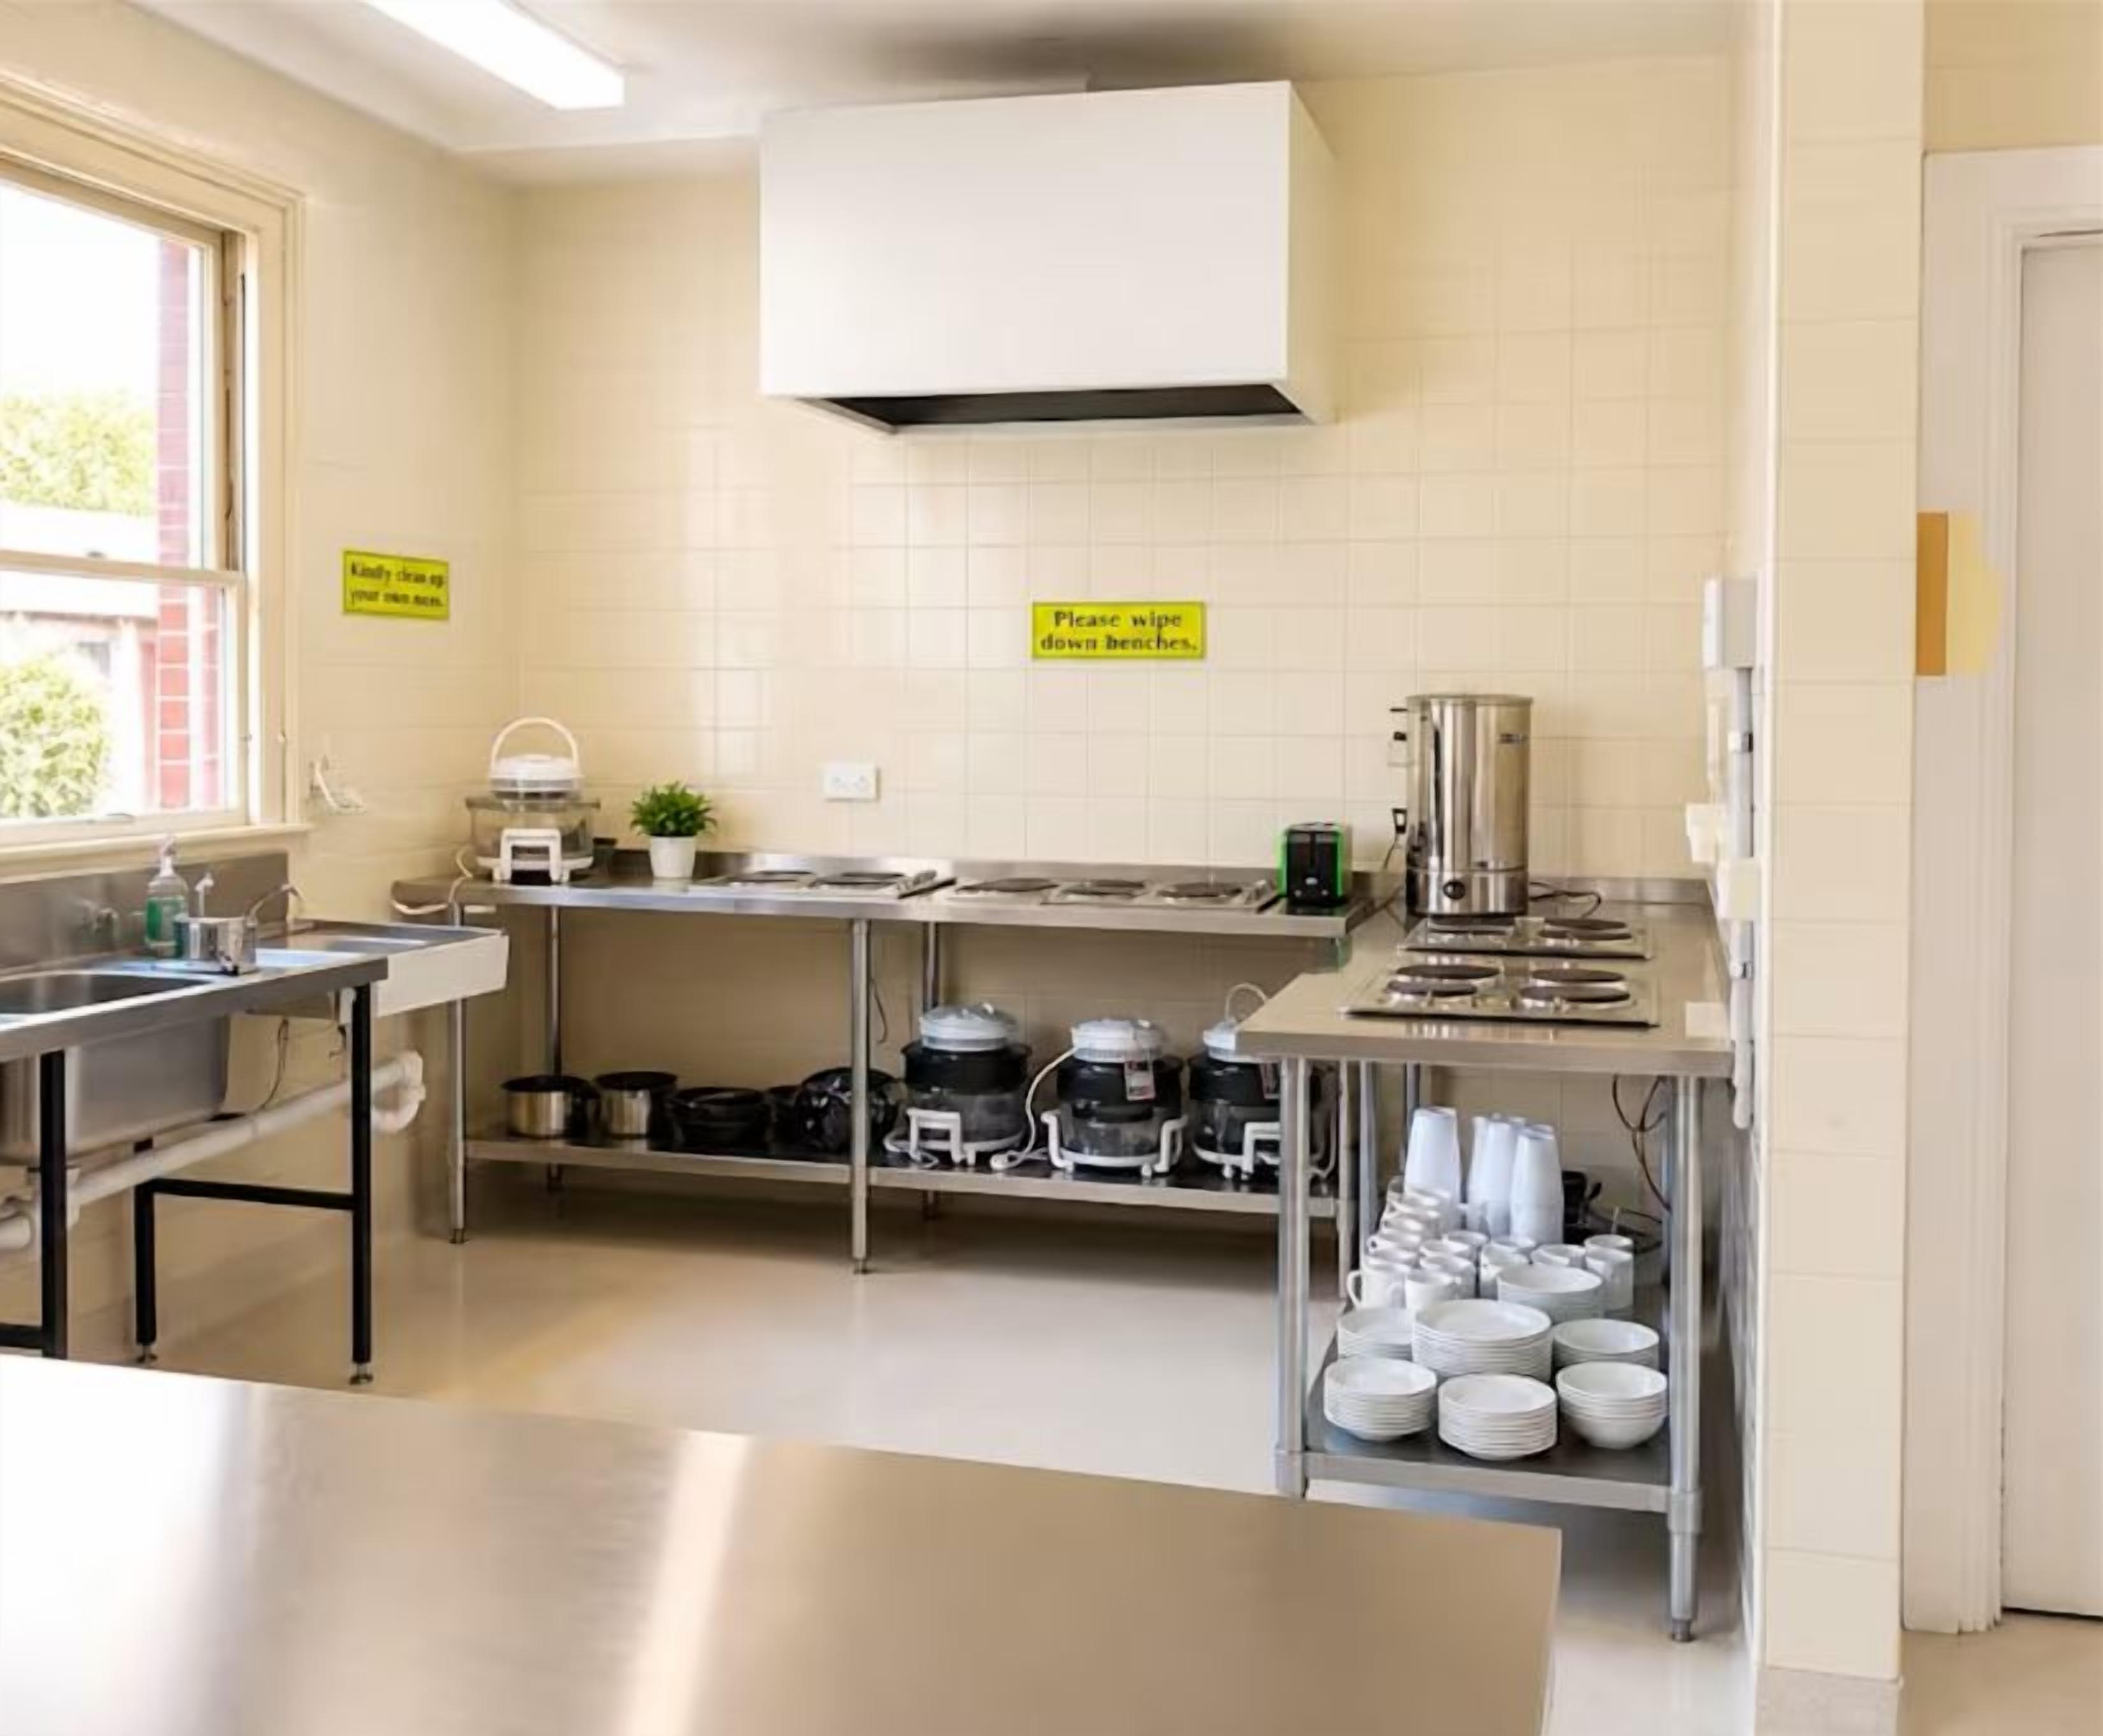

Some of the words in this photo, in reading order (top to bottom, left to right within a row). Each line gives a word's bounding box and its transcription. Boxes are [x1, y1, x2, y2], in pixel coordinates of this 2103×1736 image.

[351, 561, 391, 586] Kindly
[396, 565, 426, 583] clean
[430, 574, 444, 589] up
[350, 590, 379, 606] your
[383, 593, 409, 604] own
[1054, 611, 1120, 628] Please
[1131, 611, 1182, 630] wipe
[1041, 634, 1097, 650] down
[1106, 634, 1198, 650] benches.
